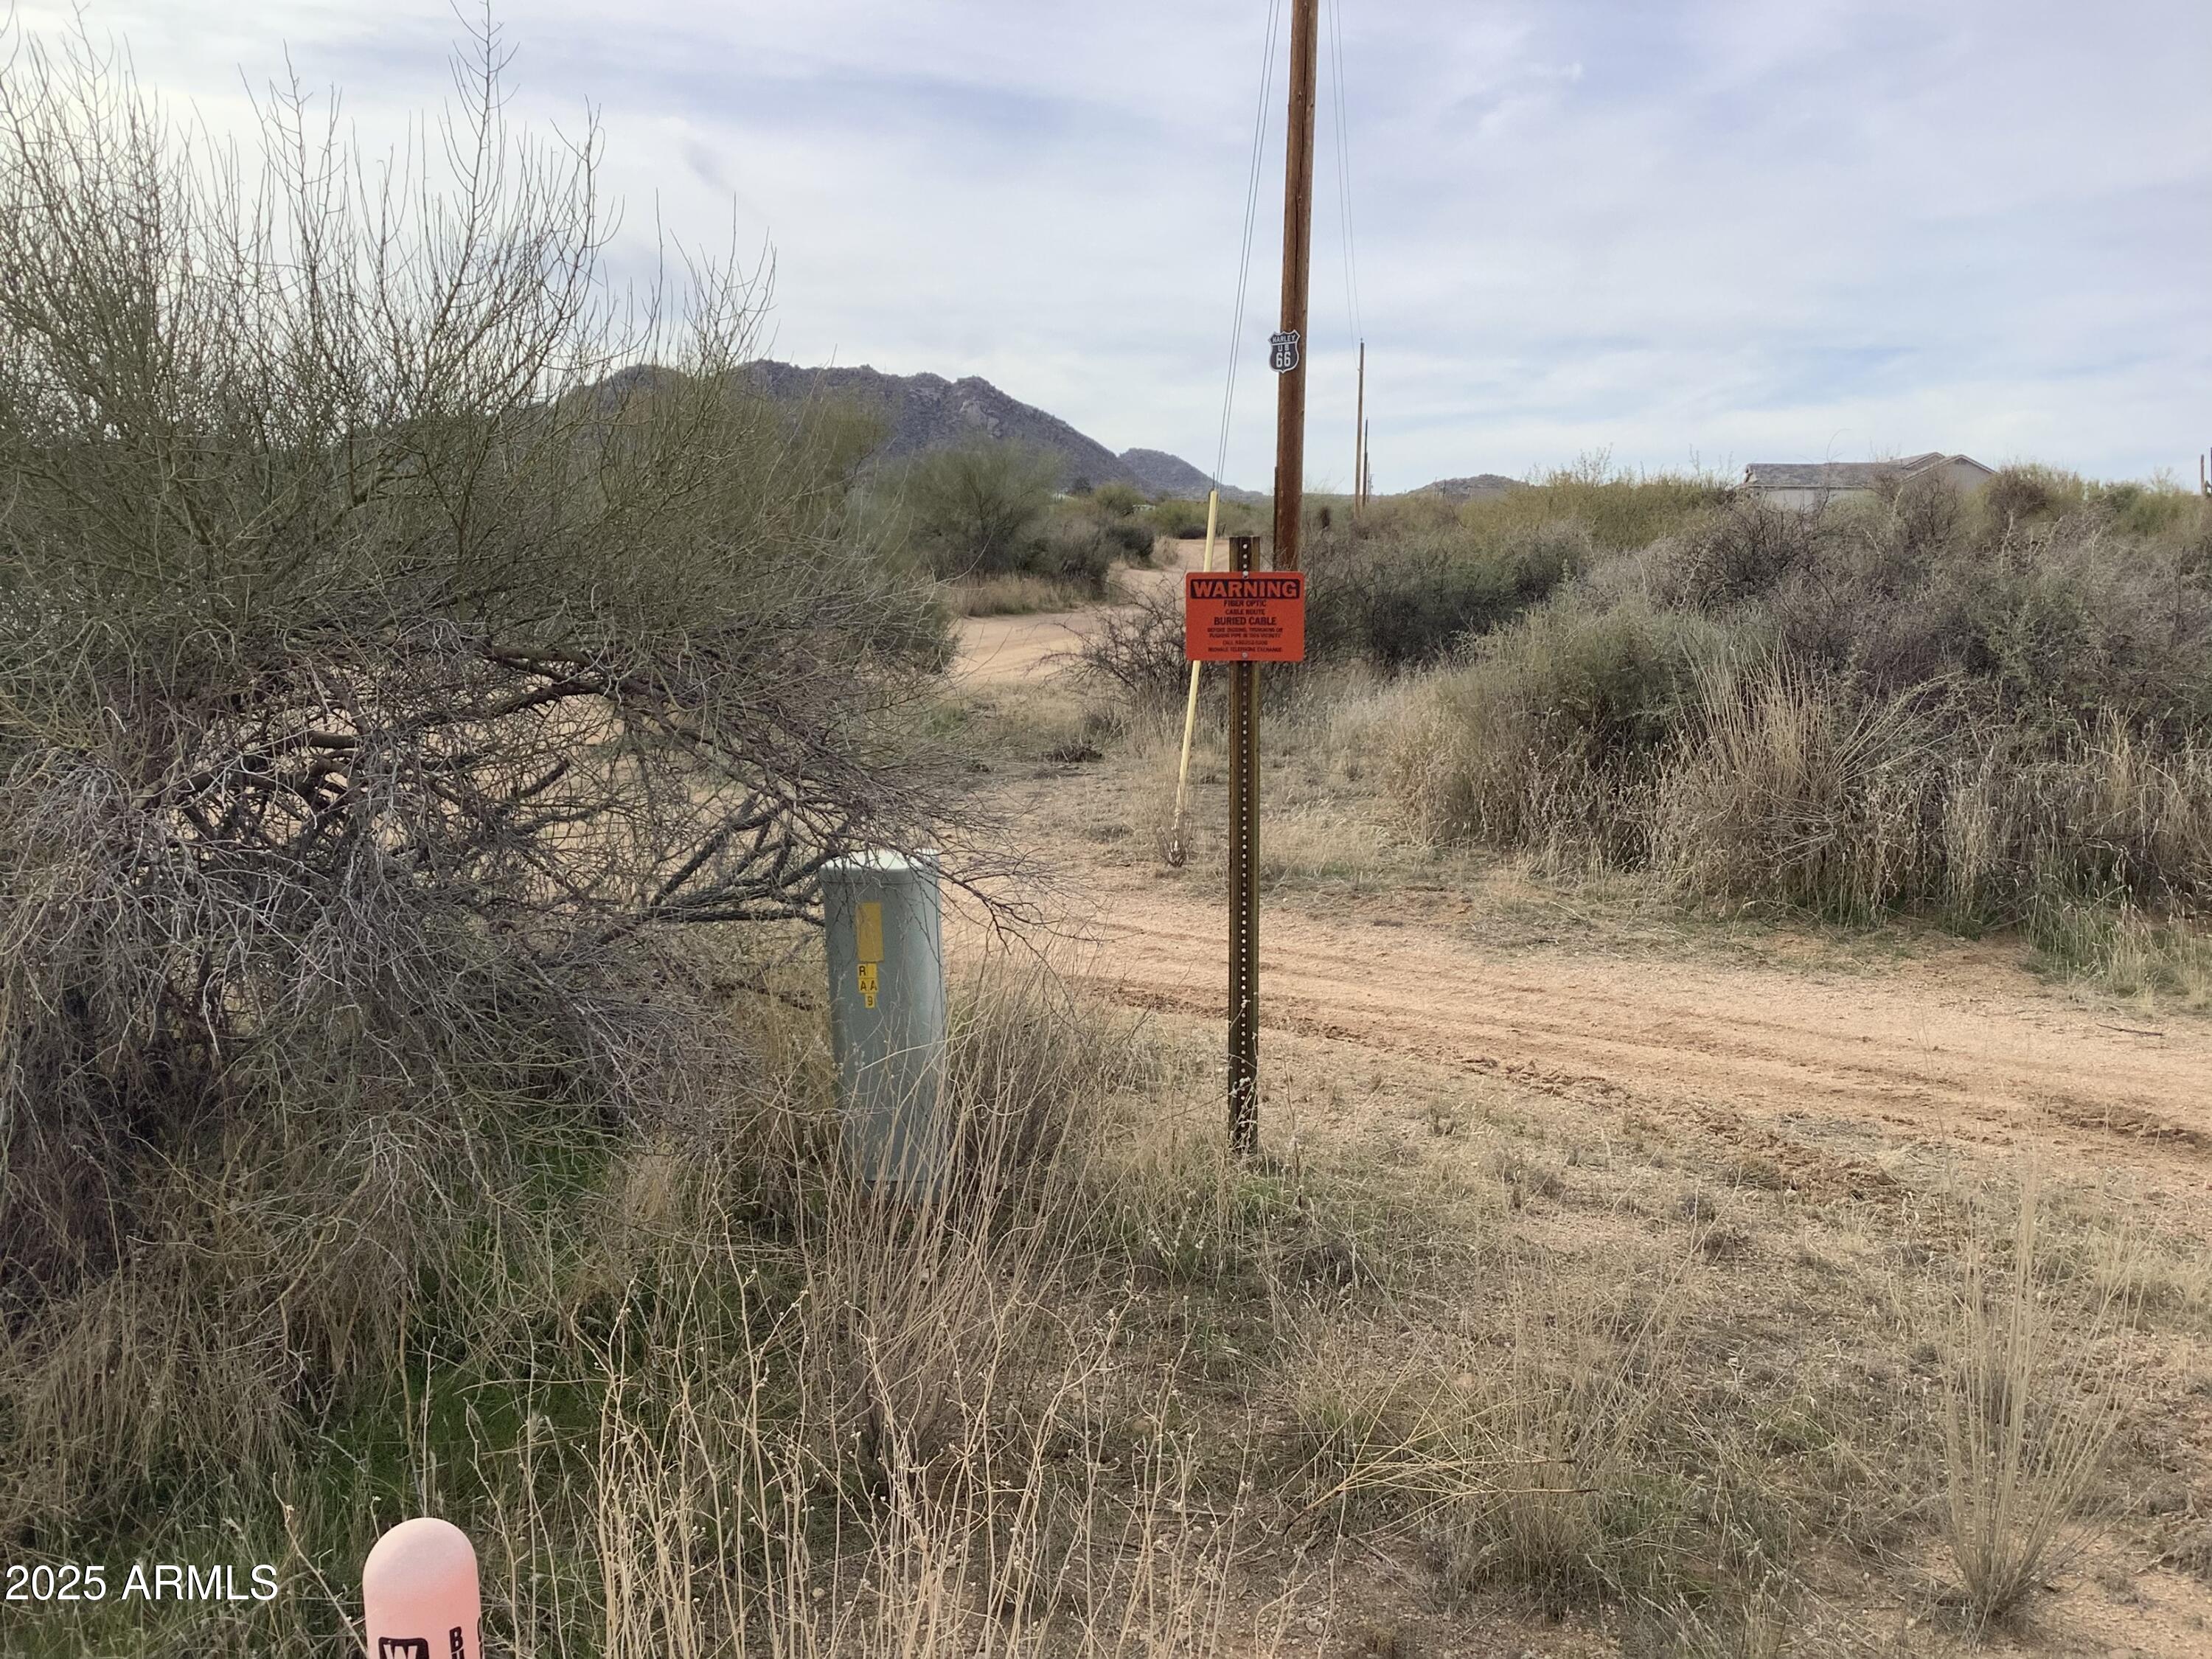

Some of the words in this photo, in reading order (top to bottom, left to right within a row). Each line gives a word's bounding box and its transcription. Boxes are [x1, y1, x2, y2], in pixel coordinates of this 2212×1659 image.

[1272, 334, 1295, 343] HARLEY
[1276, 351, 1291, 368] 66
[1192, 580, 1298, 598] WARNING
[1214, 616, 1247, 626] BURIED
[1248, 616, 1277, 626] CABLE
[859, 965, 866, 976] R
[867, 995, 873, 1006] 9
